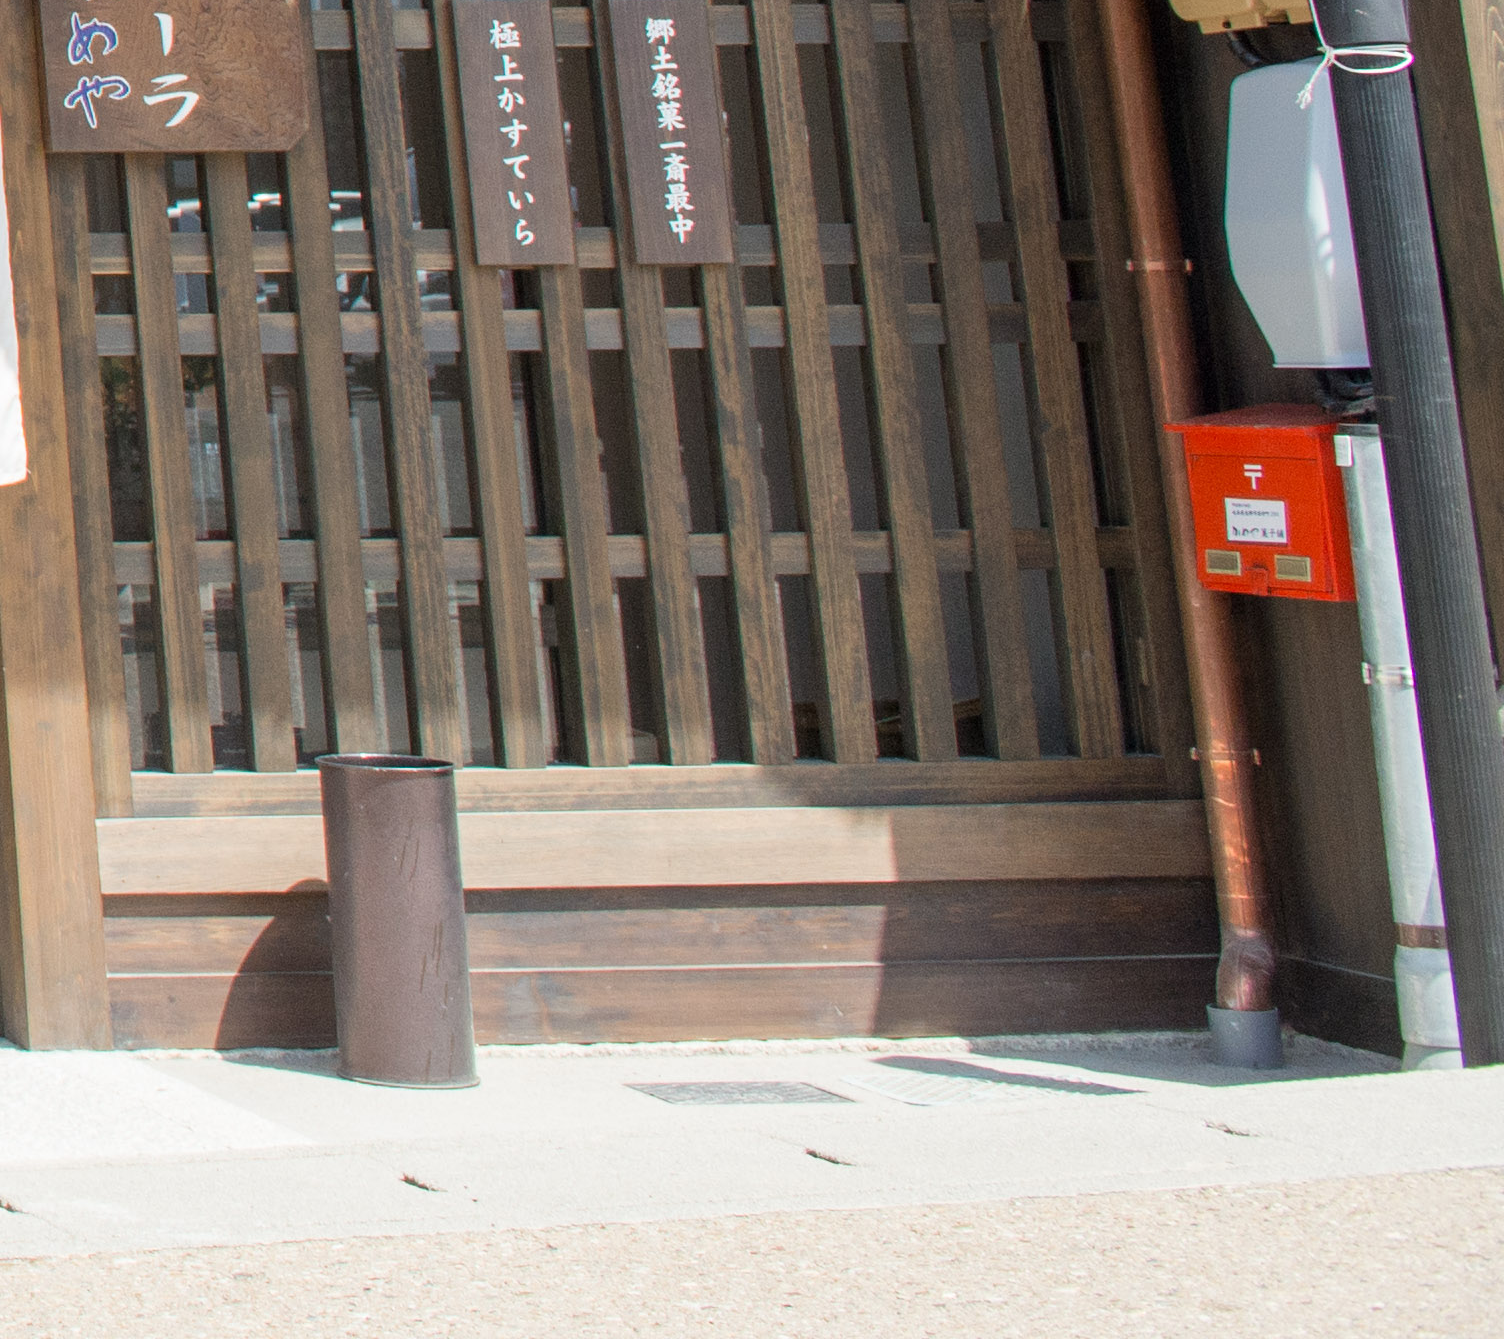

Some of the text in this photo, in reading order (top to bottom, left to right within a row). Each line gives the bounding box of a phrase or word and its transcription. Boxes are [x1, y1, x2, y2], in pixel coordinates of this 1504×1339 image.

[490, 19, 535, 246] 極上かすていら
[645, 17, 695, 244] 郷土銘菓一斎最中
